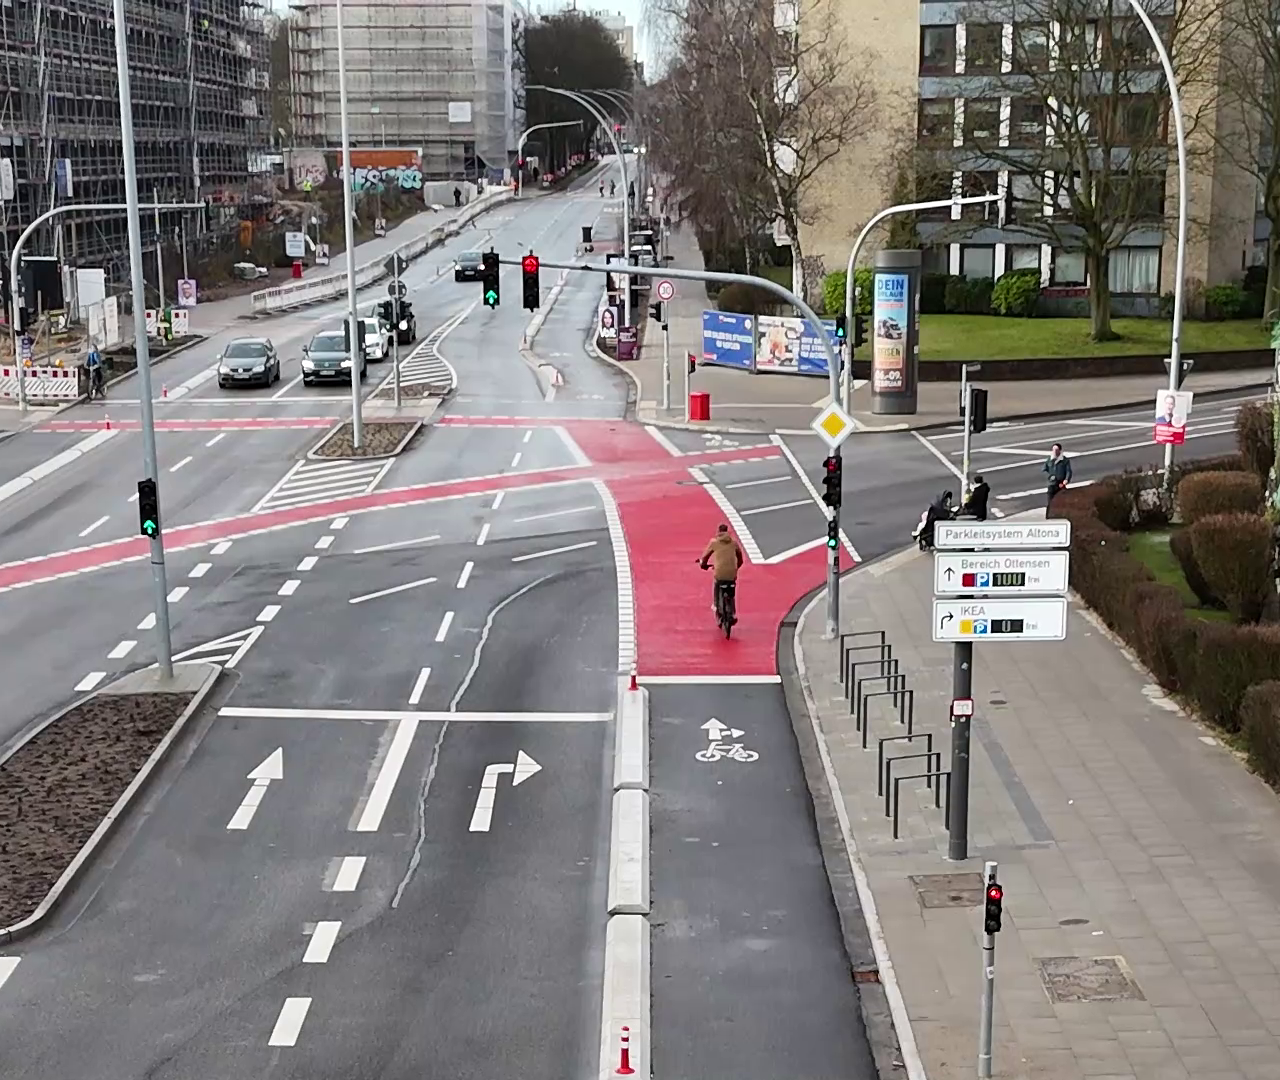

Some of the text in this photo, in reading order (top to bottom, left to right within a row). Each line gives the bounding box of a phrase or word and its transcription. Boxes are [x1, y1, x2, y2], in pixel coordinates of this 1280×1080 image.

[877, 279, 904, 290] DEIN
[661, 286, 671, 295] 30
[945, 528, 1060, 541] Parkleitsystem Altona
[961, 558, 1051, 570] Bereich Ottensen
[960, 606, 986, 616] IKEA
[1025, 621, 1038, 630] frei
